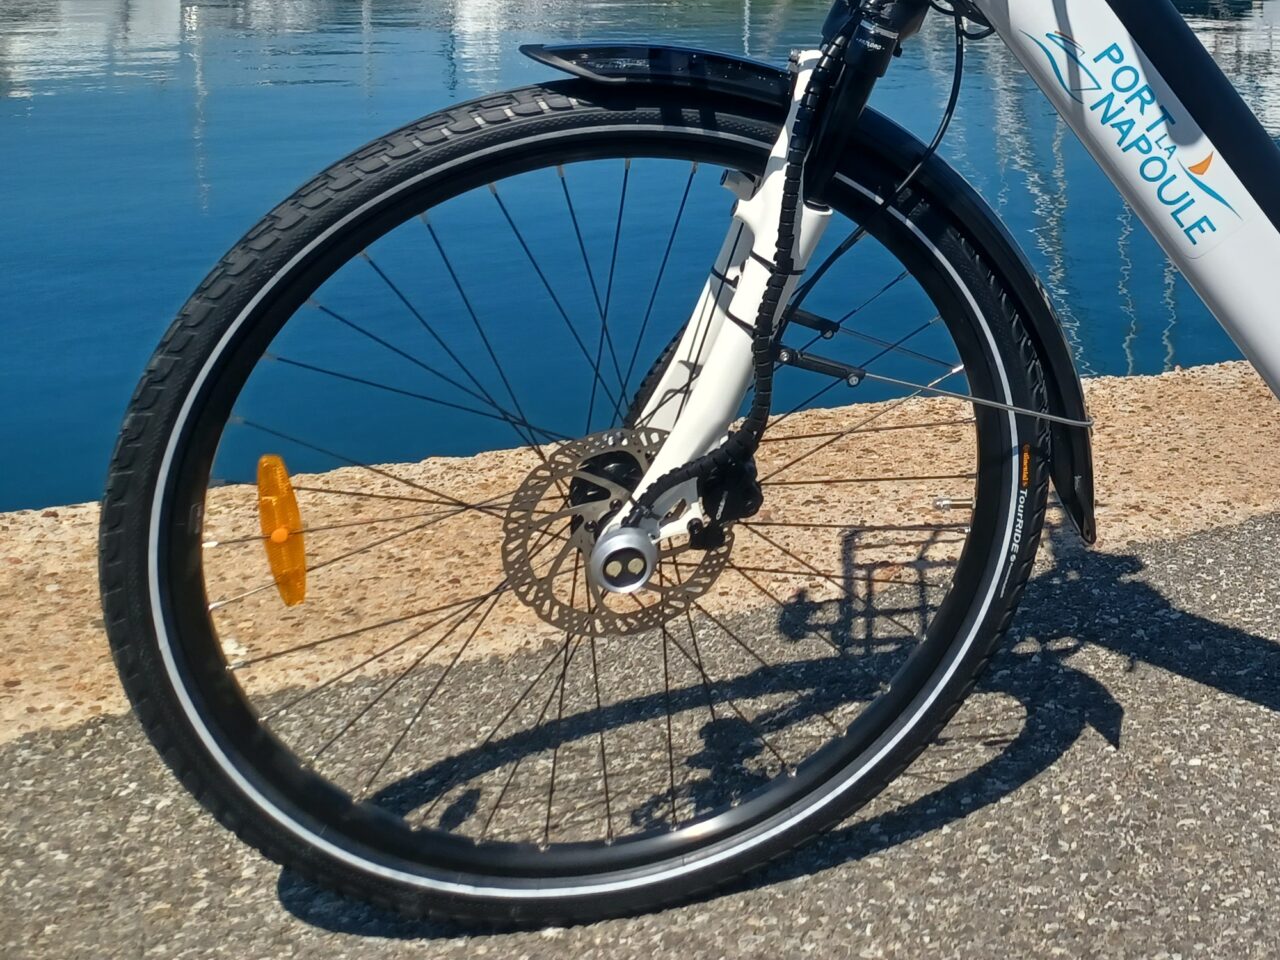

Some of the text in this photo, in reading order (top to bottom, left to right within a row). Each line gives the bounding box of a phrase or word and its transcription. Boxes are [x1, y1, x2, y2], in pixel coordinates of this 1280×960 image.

[1092, 42, 1177, 161] PORT LA
[1090, 92, 1216, 246] NAPOULE
[1010, 489, 1028, 554] TourRIDE
